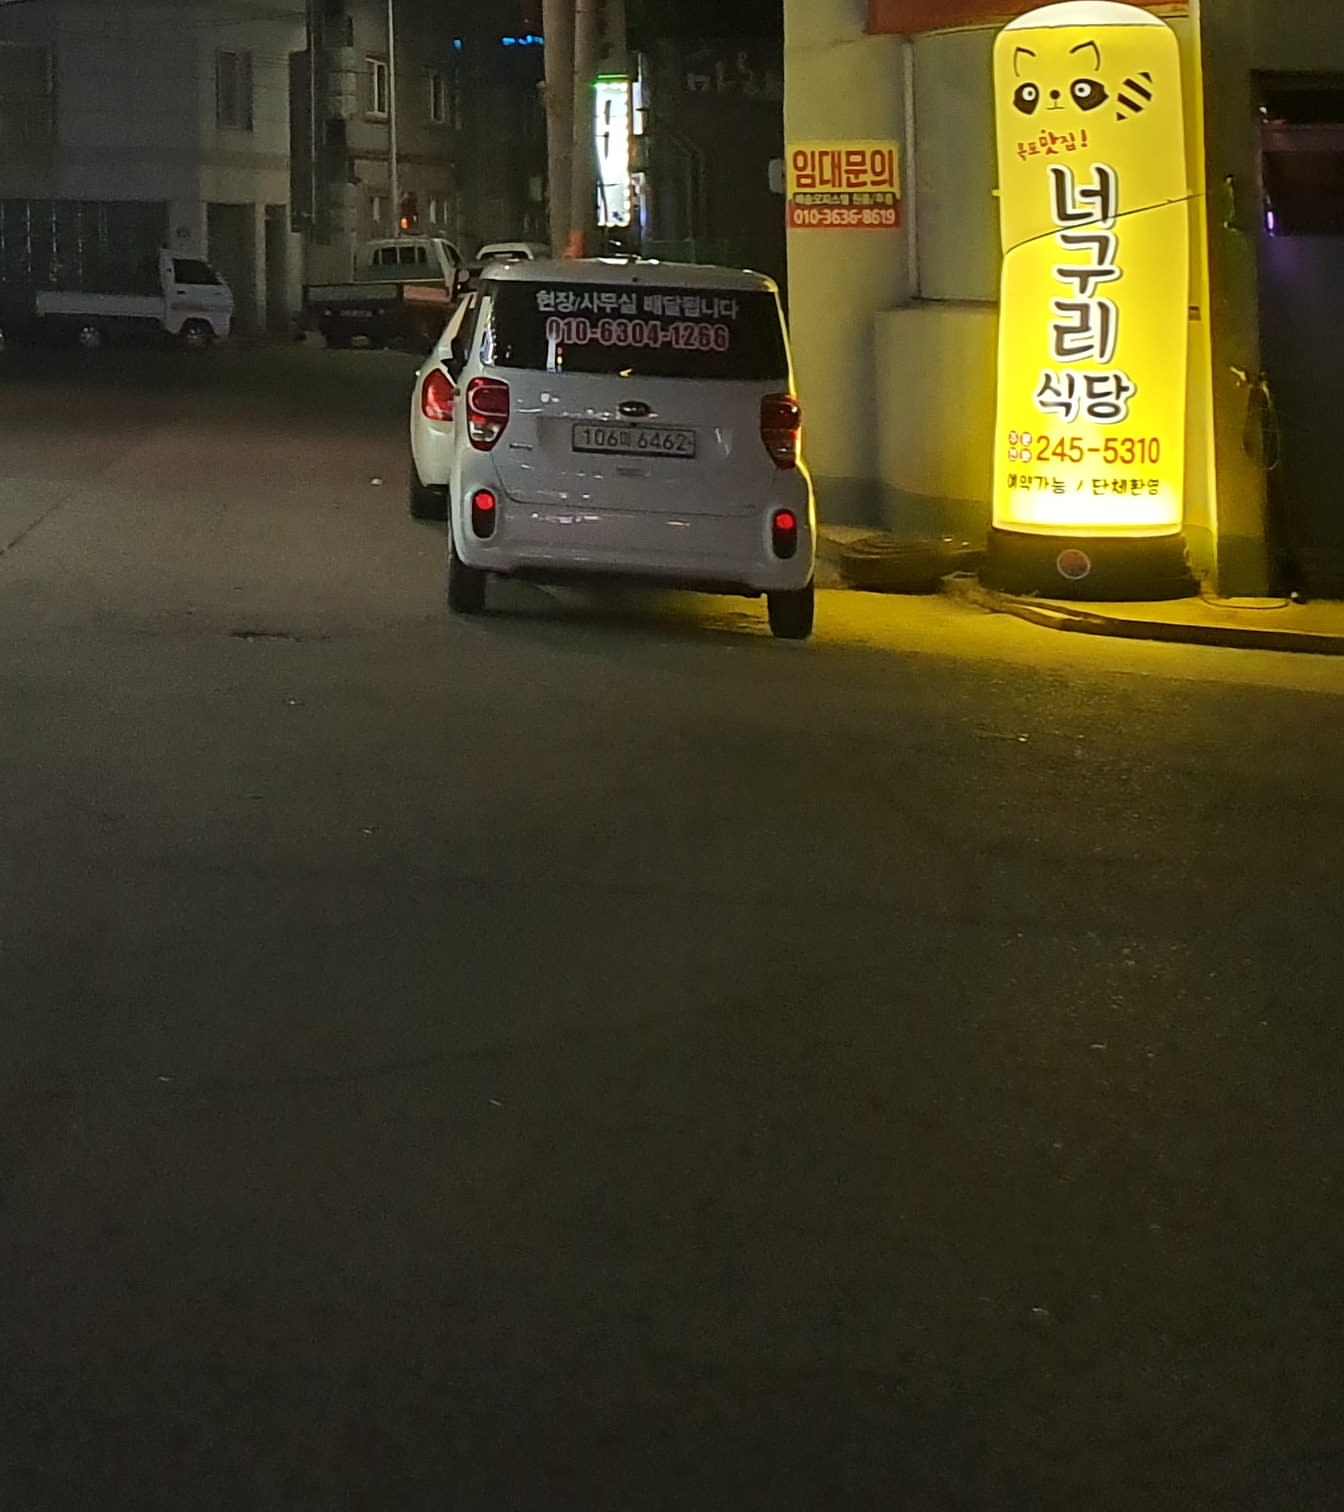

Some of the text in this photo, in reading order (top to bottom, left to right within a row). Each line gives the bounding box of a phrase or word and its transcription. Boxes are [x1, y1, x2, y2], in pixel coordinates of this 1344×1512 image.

[1016, 128, 1089, 162] 목포맛집!
[792, 149, 895, 189] 임대문의
[793, 208, 896, 226] 010-3636-8619
[1047, 162, 1120, 365] 너구리
[535, 289, 739, 319] 현장/사무실 배달됩니다
[545, 316, 730, 350] 010-6304-1266
[1033, 369, 1135, 424] 식당
[636, 431, 687, 451] 6462
[1035, 434, 1161, 465] 245-5310
[1007, 472, 1066, 495] 예약가능
[1092, 478, 1160, 496] 단체환영
